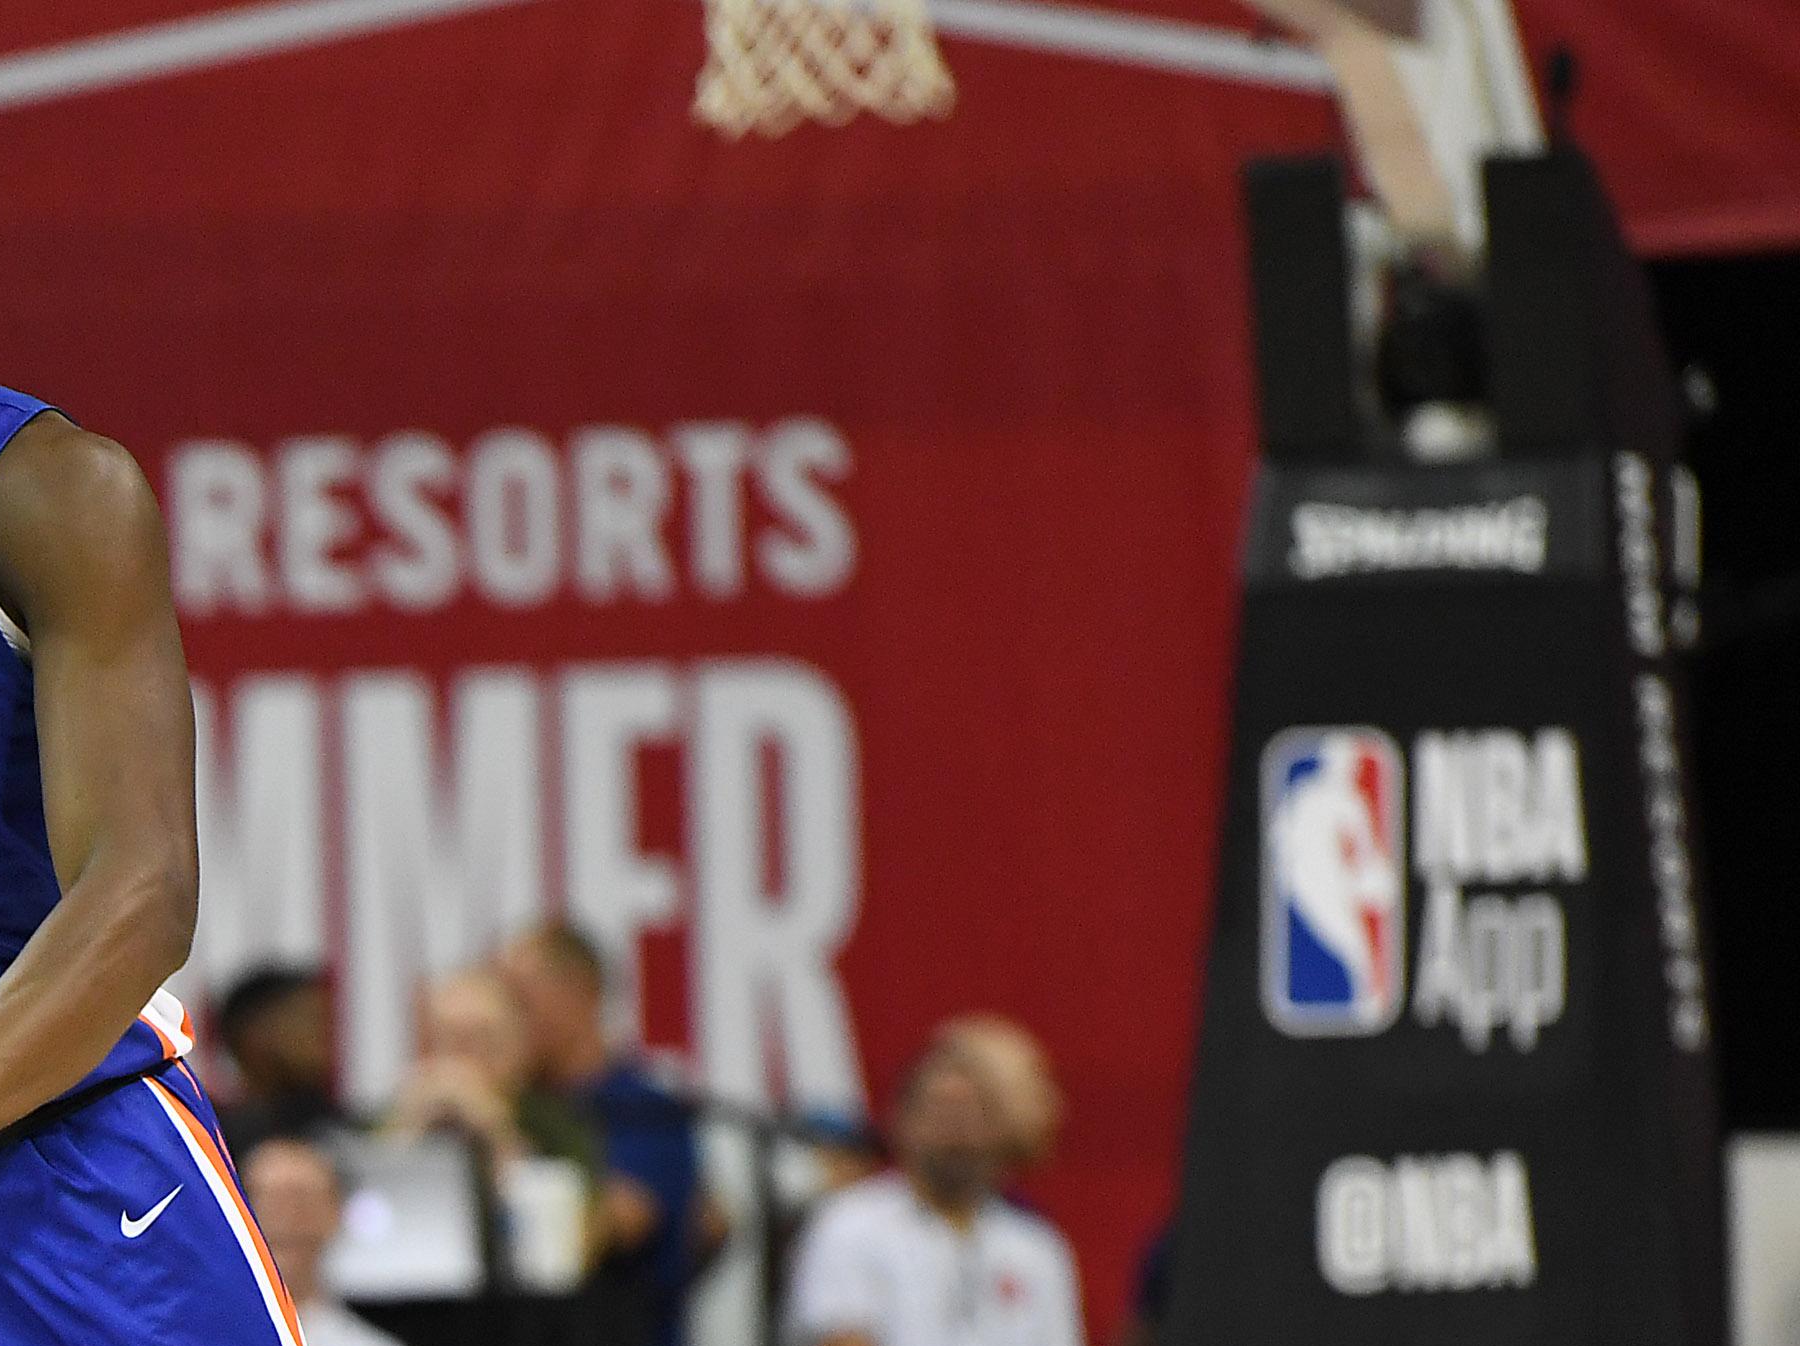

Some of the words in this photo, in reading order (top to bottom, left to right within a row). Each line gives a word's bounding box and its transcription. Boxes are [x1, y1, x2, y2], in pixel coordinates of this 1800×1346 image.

[167, 415, 857, 615] RESORTS
[185, 655, 865, 1110] MMER
[1413, 727, 1588, 882] NBA
[1413, 888, 1565, 1053] App
[1316, 1148, 1537, 1295] @NBA
